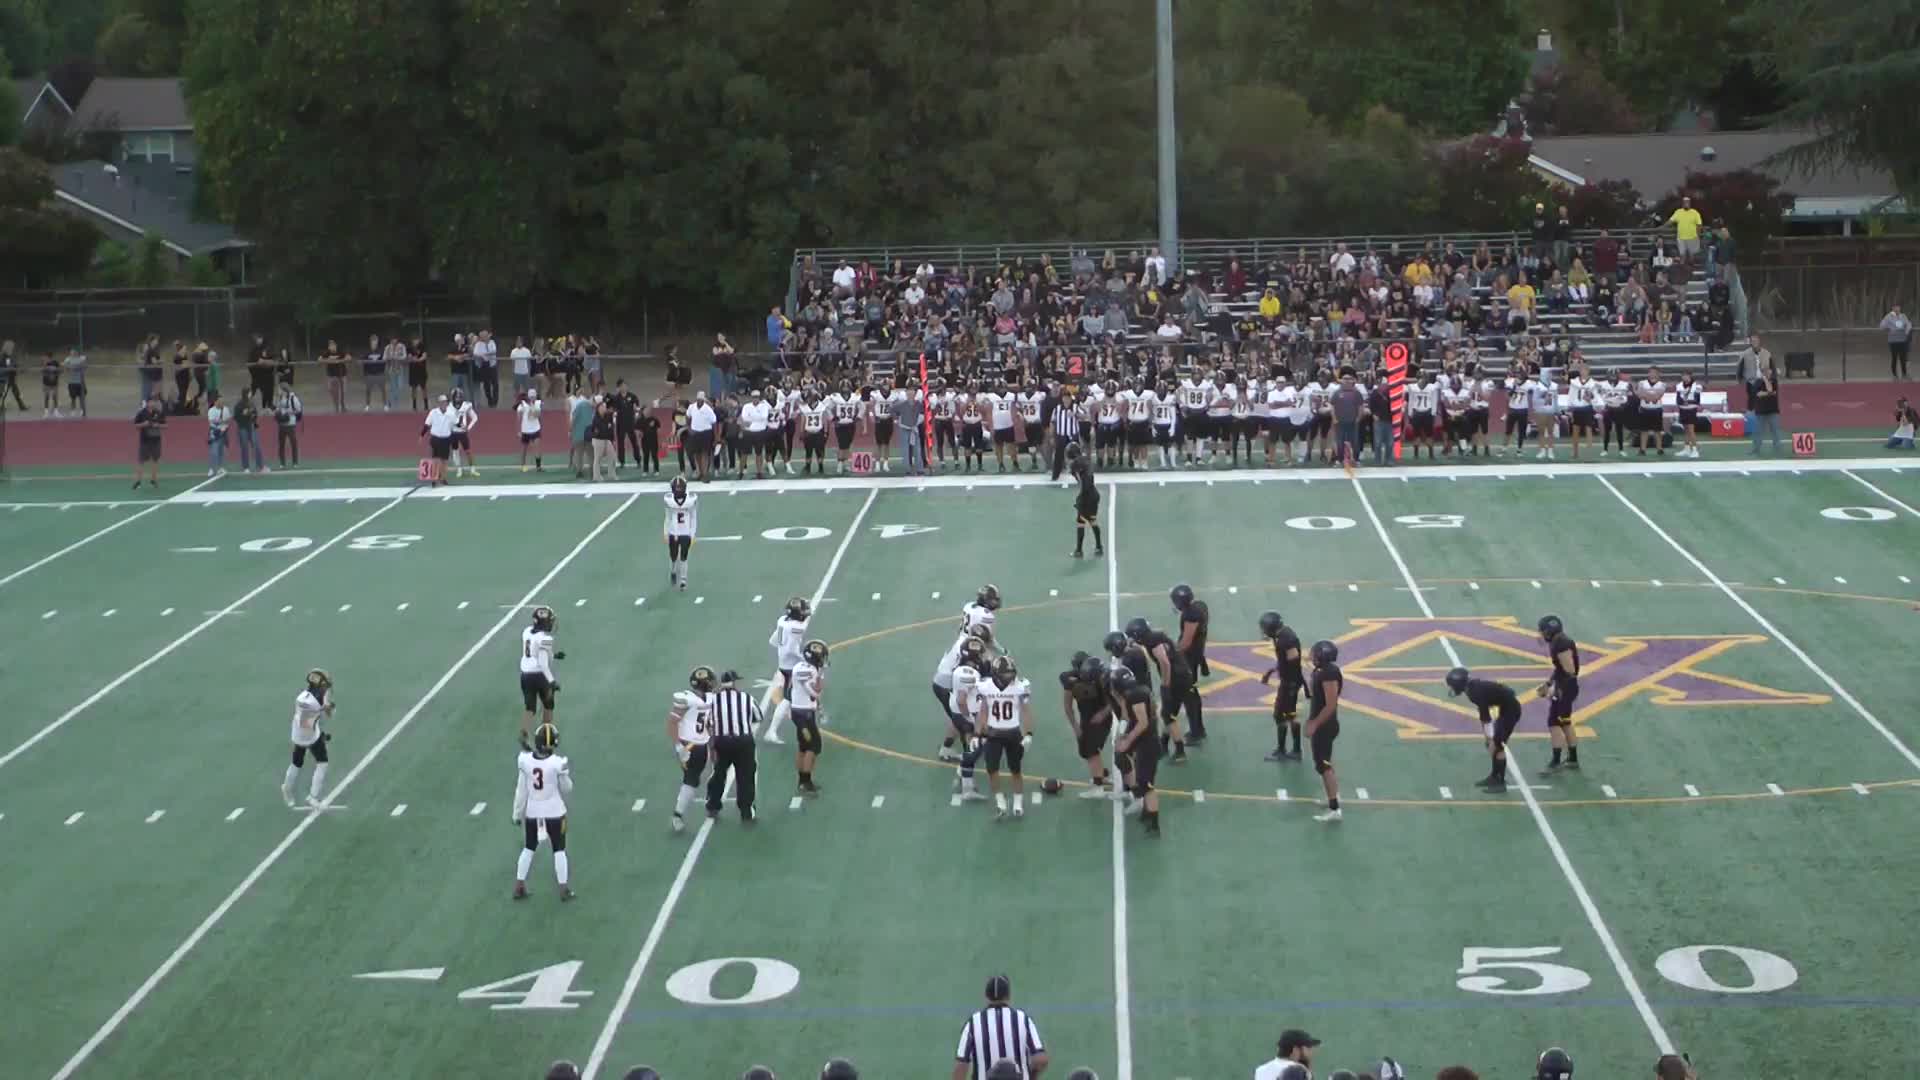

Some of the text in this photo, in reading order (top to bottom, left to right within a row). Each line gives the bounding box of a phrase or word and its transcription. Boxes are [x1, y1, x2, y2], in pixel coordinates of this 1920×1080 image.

[1068, 357, 1082, 375] 2
[1796, 434, 1813, 452] 40
[854, 453, 871, 471] 40
[991, 700, 1013, 722] 40
[532, 767, 544, 790] 3
